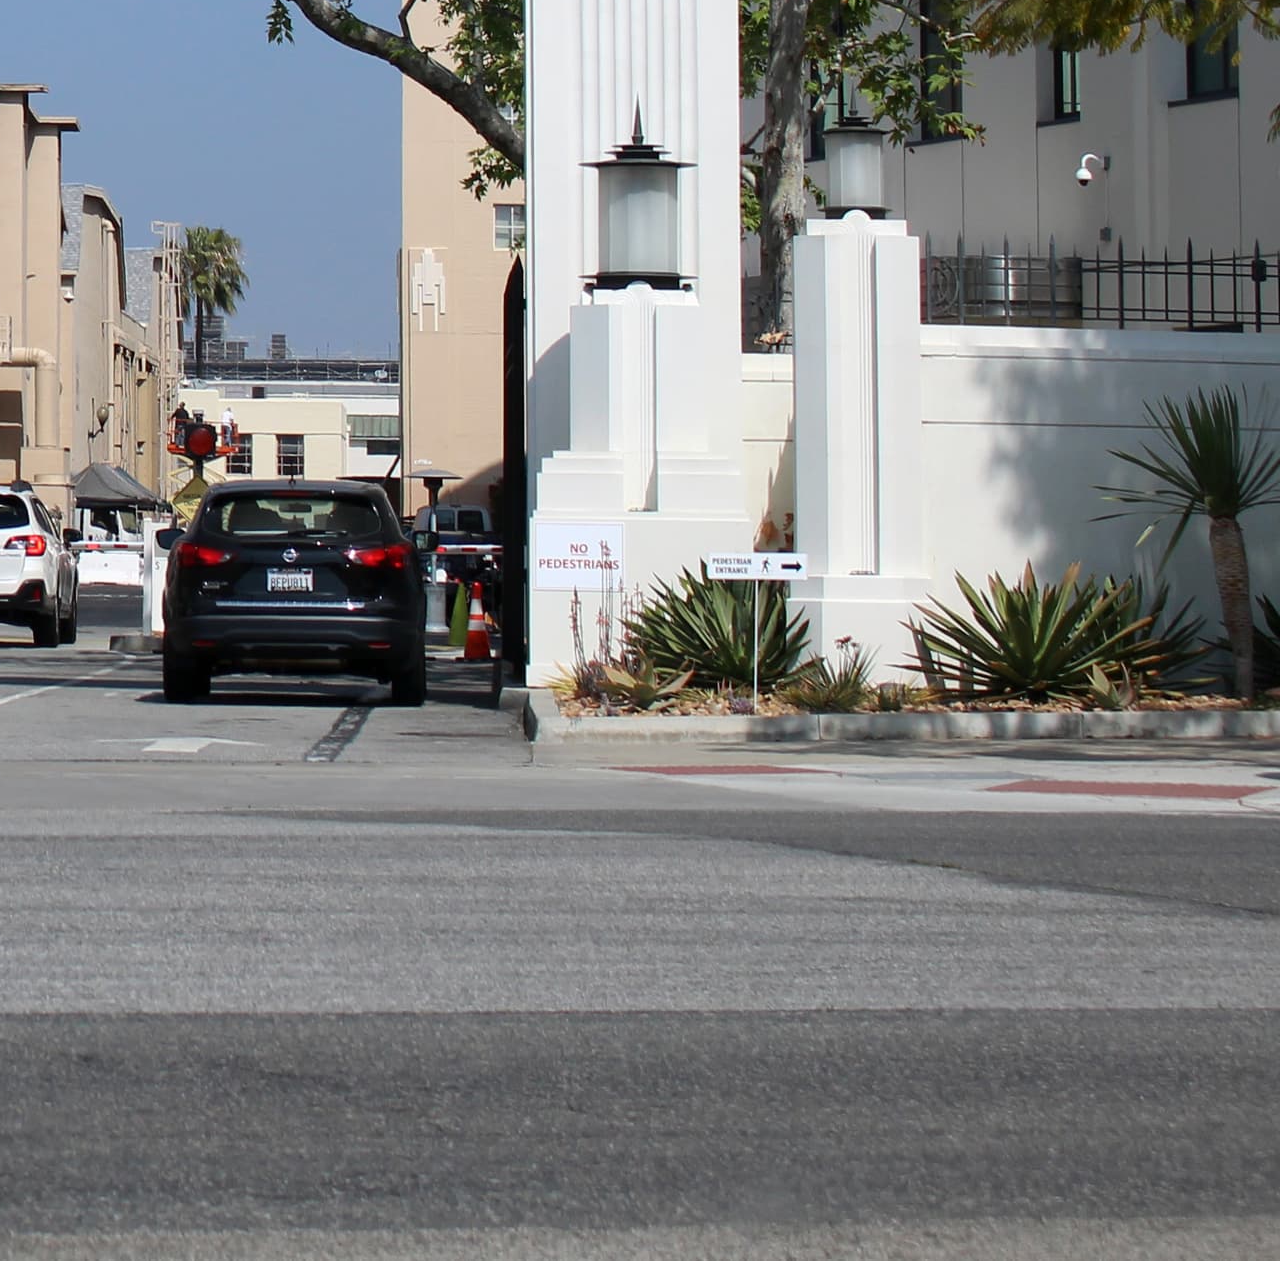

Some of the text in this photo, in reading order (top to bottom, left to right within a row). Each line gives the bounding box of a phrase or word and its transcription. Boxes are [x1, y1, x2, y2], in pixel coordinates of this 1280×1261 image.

[570, 543, 588, 554] NO
[539, 559, 620, 570] PEDESTRIANS
[712, 557, 752, 565] PEDESTRIAN
